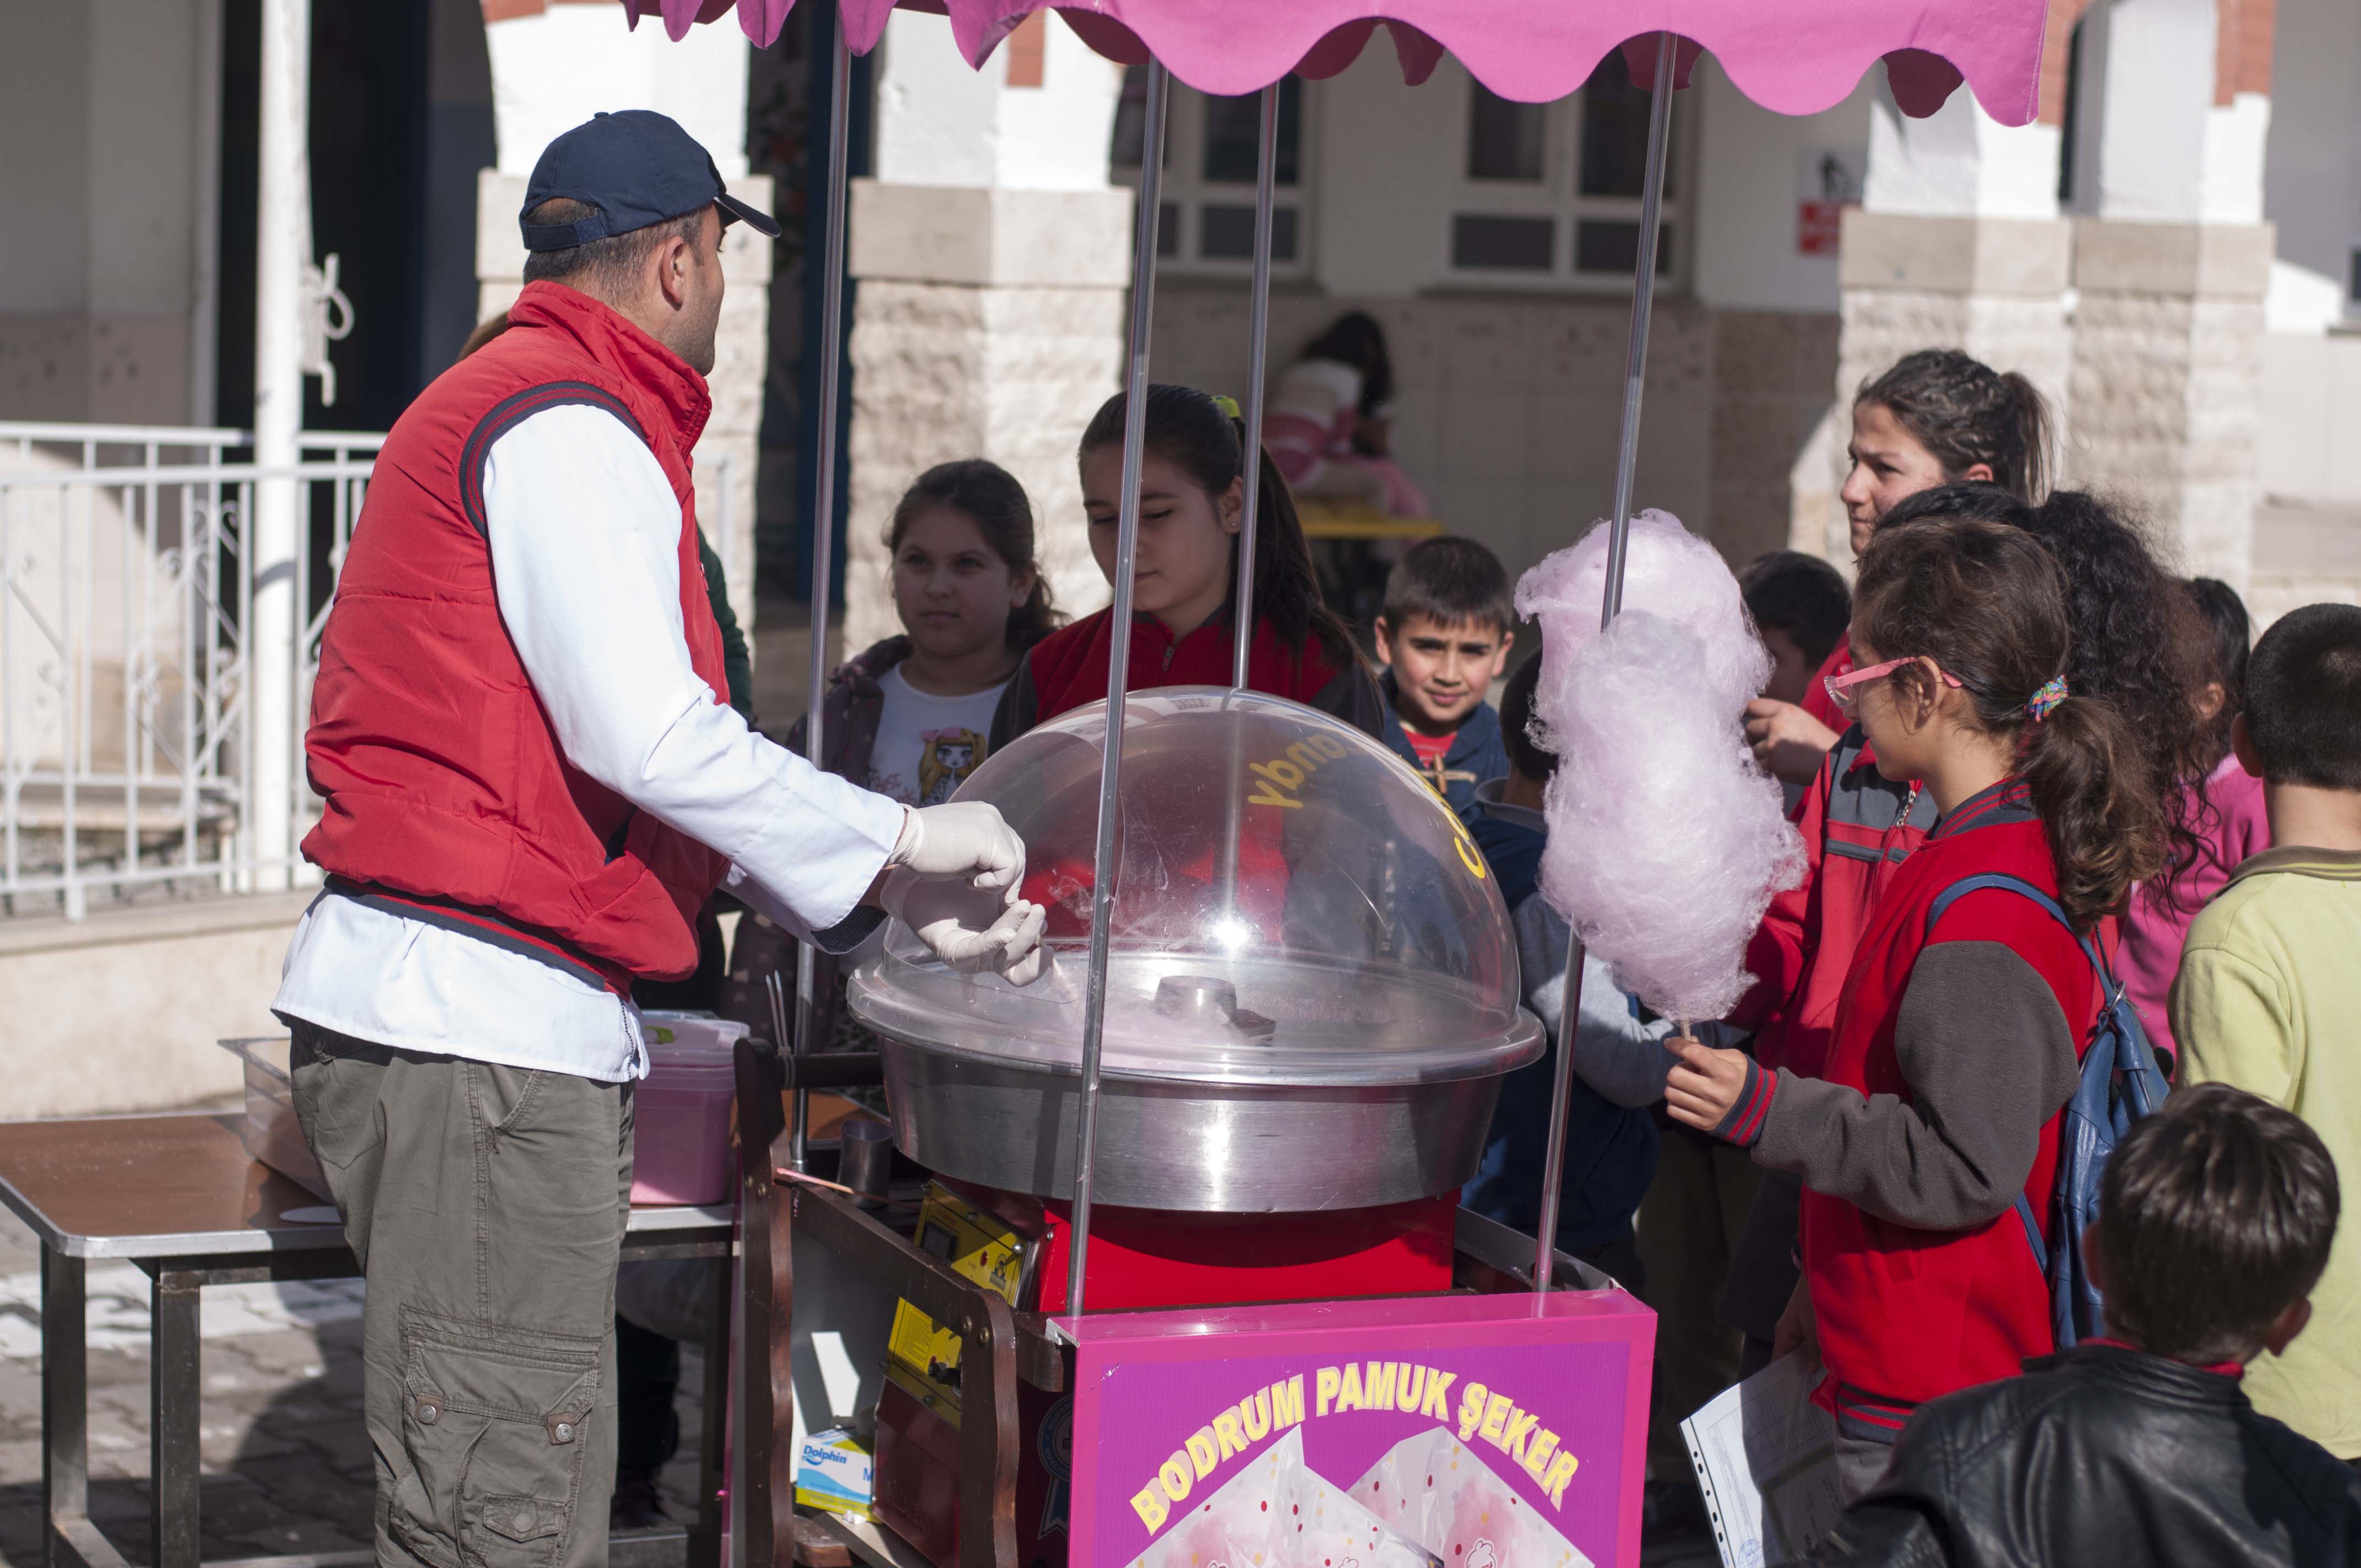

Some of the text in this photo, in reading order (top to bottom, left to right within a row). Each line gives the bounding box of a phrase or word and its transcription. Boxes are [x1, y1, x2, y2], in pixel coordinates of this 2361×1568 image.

[803, 1445, 847, 1464] Dolphin
[1130, 1373, 1305, 1537] BODRUM
[1316, 1361, 1458, 1422] PAMUK
[1458, 1382, 1579, 1512] ŞEKER
